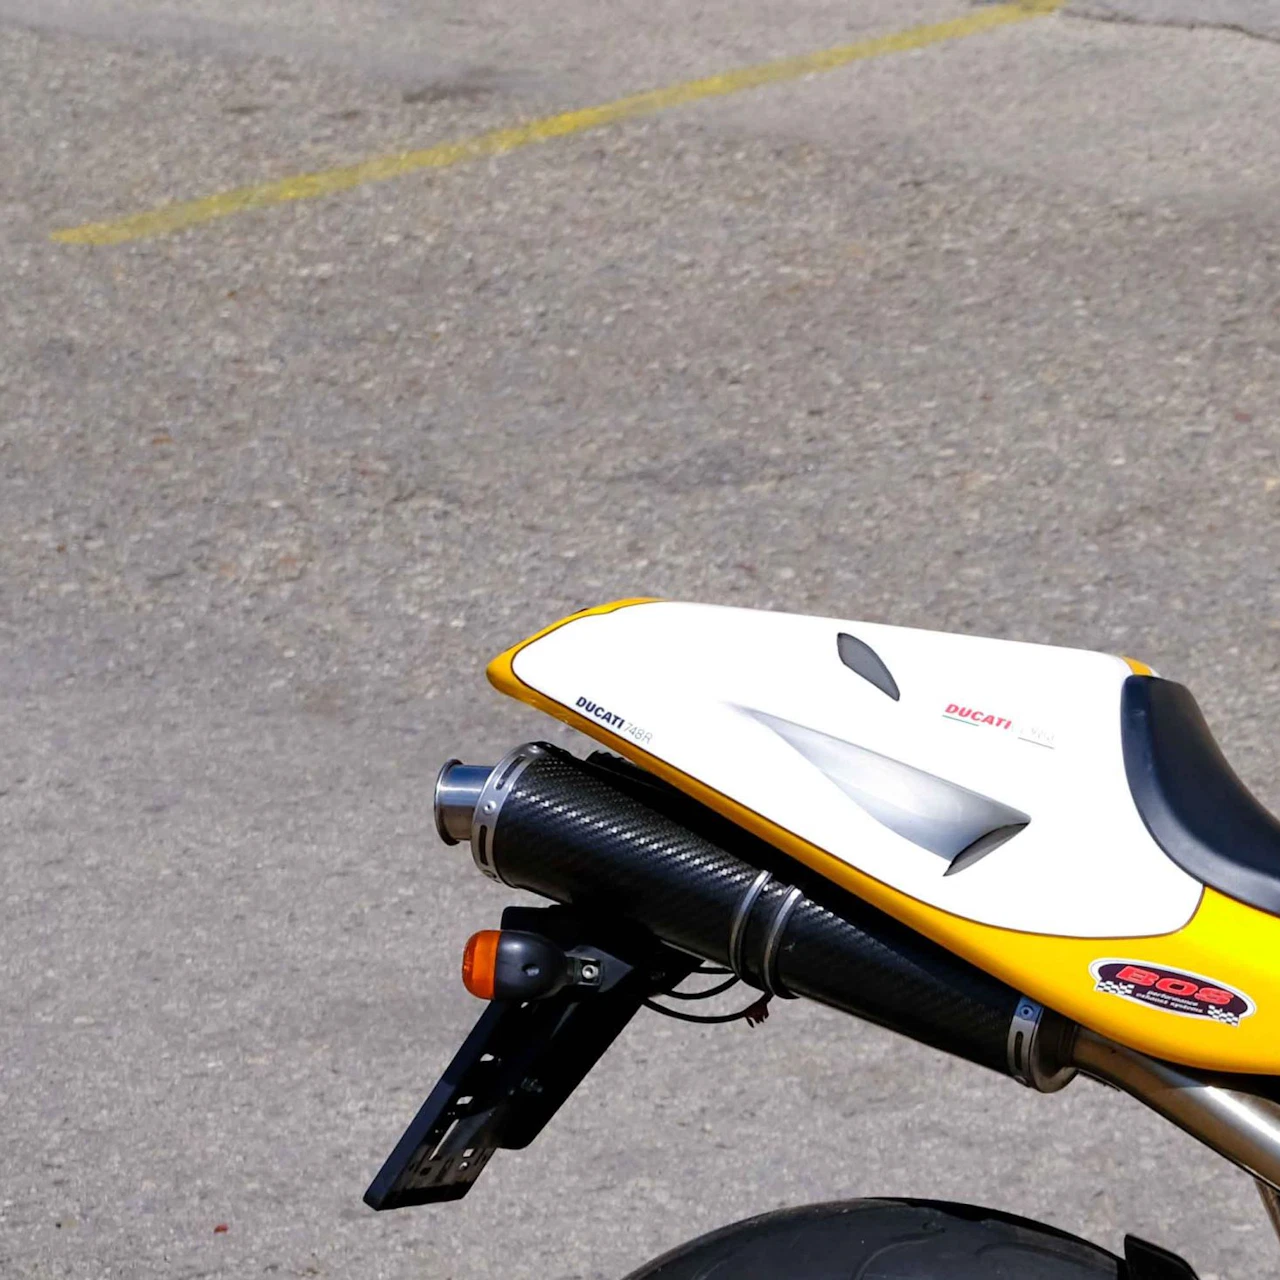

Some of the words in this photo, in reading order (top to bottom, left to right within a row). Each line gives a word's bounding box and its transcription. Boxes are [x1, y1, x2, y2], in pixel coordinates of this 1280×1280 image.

[575, 696, 625, 729] DUCATI
[945, 703, 1012, 730] DUCATI
[1115, 965, 1234, 1005] BOS
